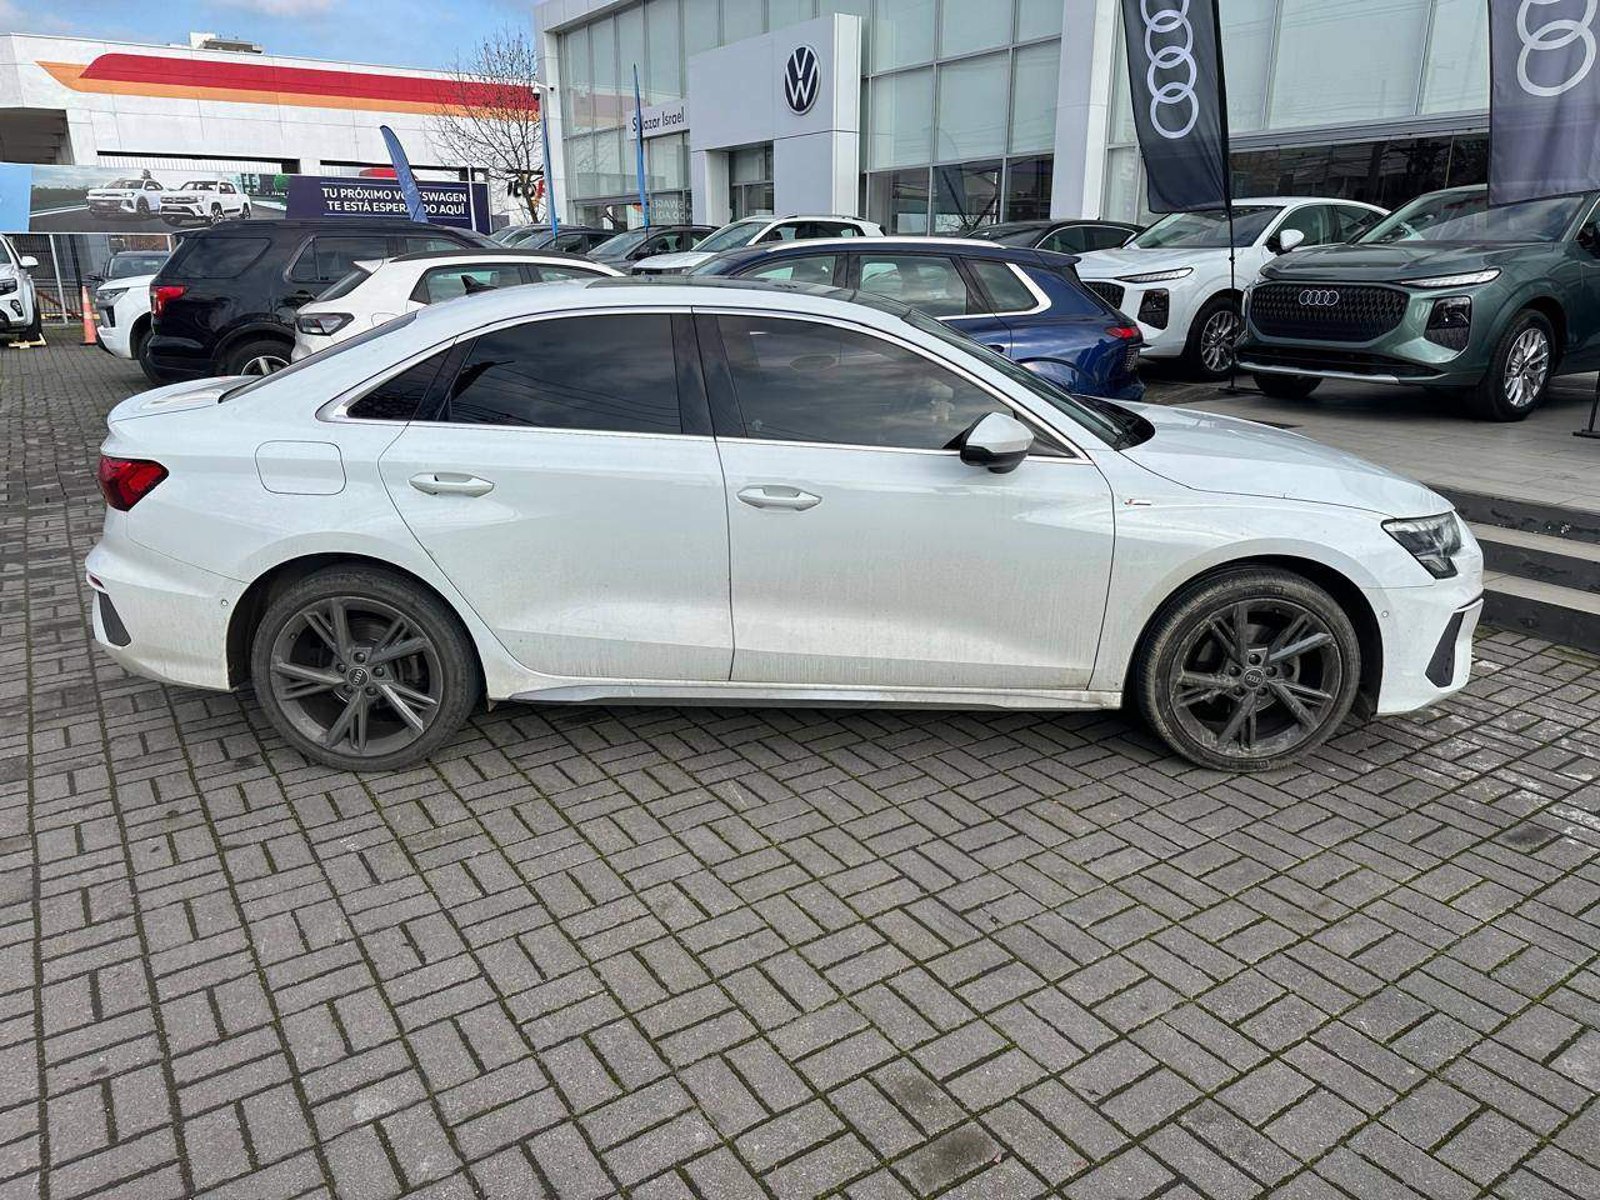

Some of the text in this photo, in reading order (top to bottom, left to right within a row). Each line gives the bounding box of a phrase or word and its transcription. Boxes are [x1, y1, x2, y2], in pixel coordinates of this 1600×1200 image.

[632, 106, 685, 132] Sazar Israel
[321, 187, 467, 202] TU PRÓXIMO VSWAGEN
[327, 199, 465, 215] TE ESTÁ ESPERDO AQUÍ
